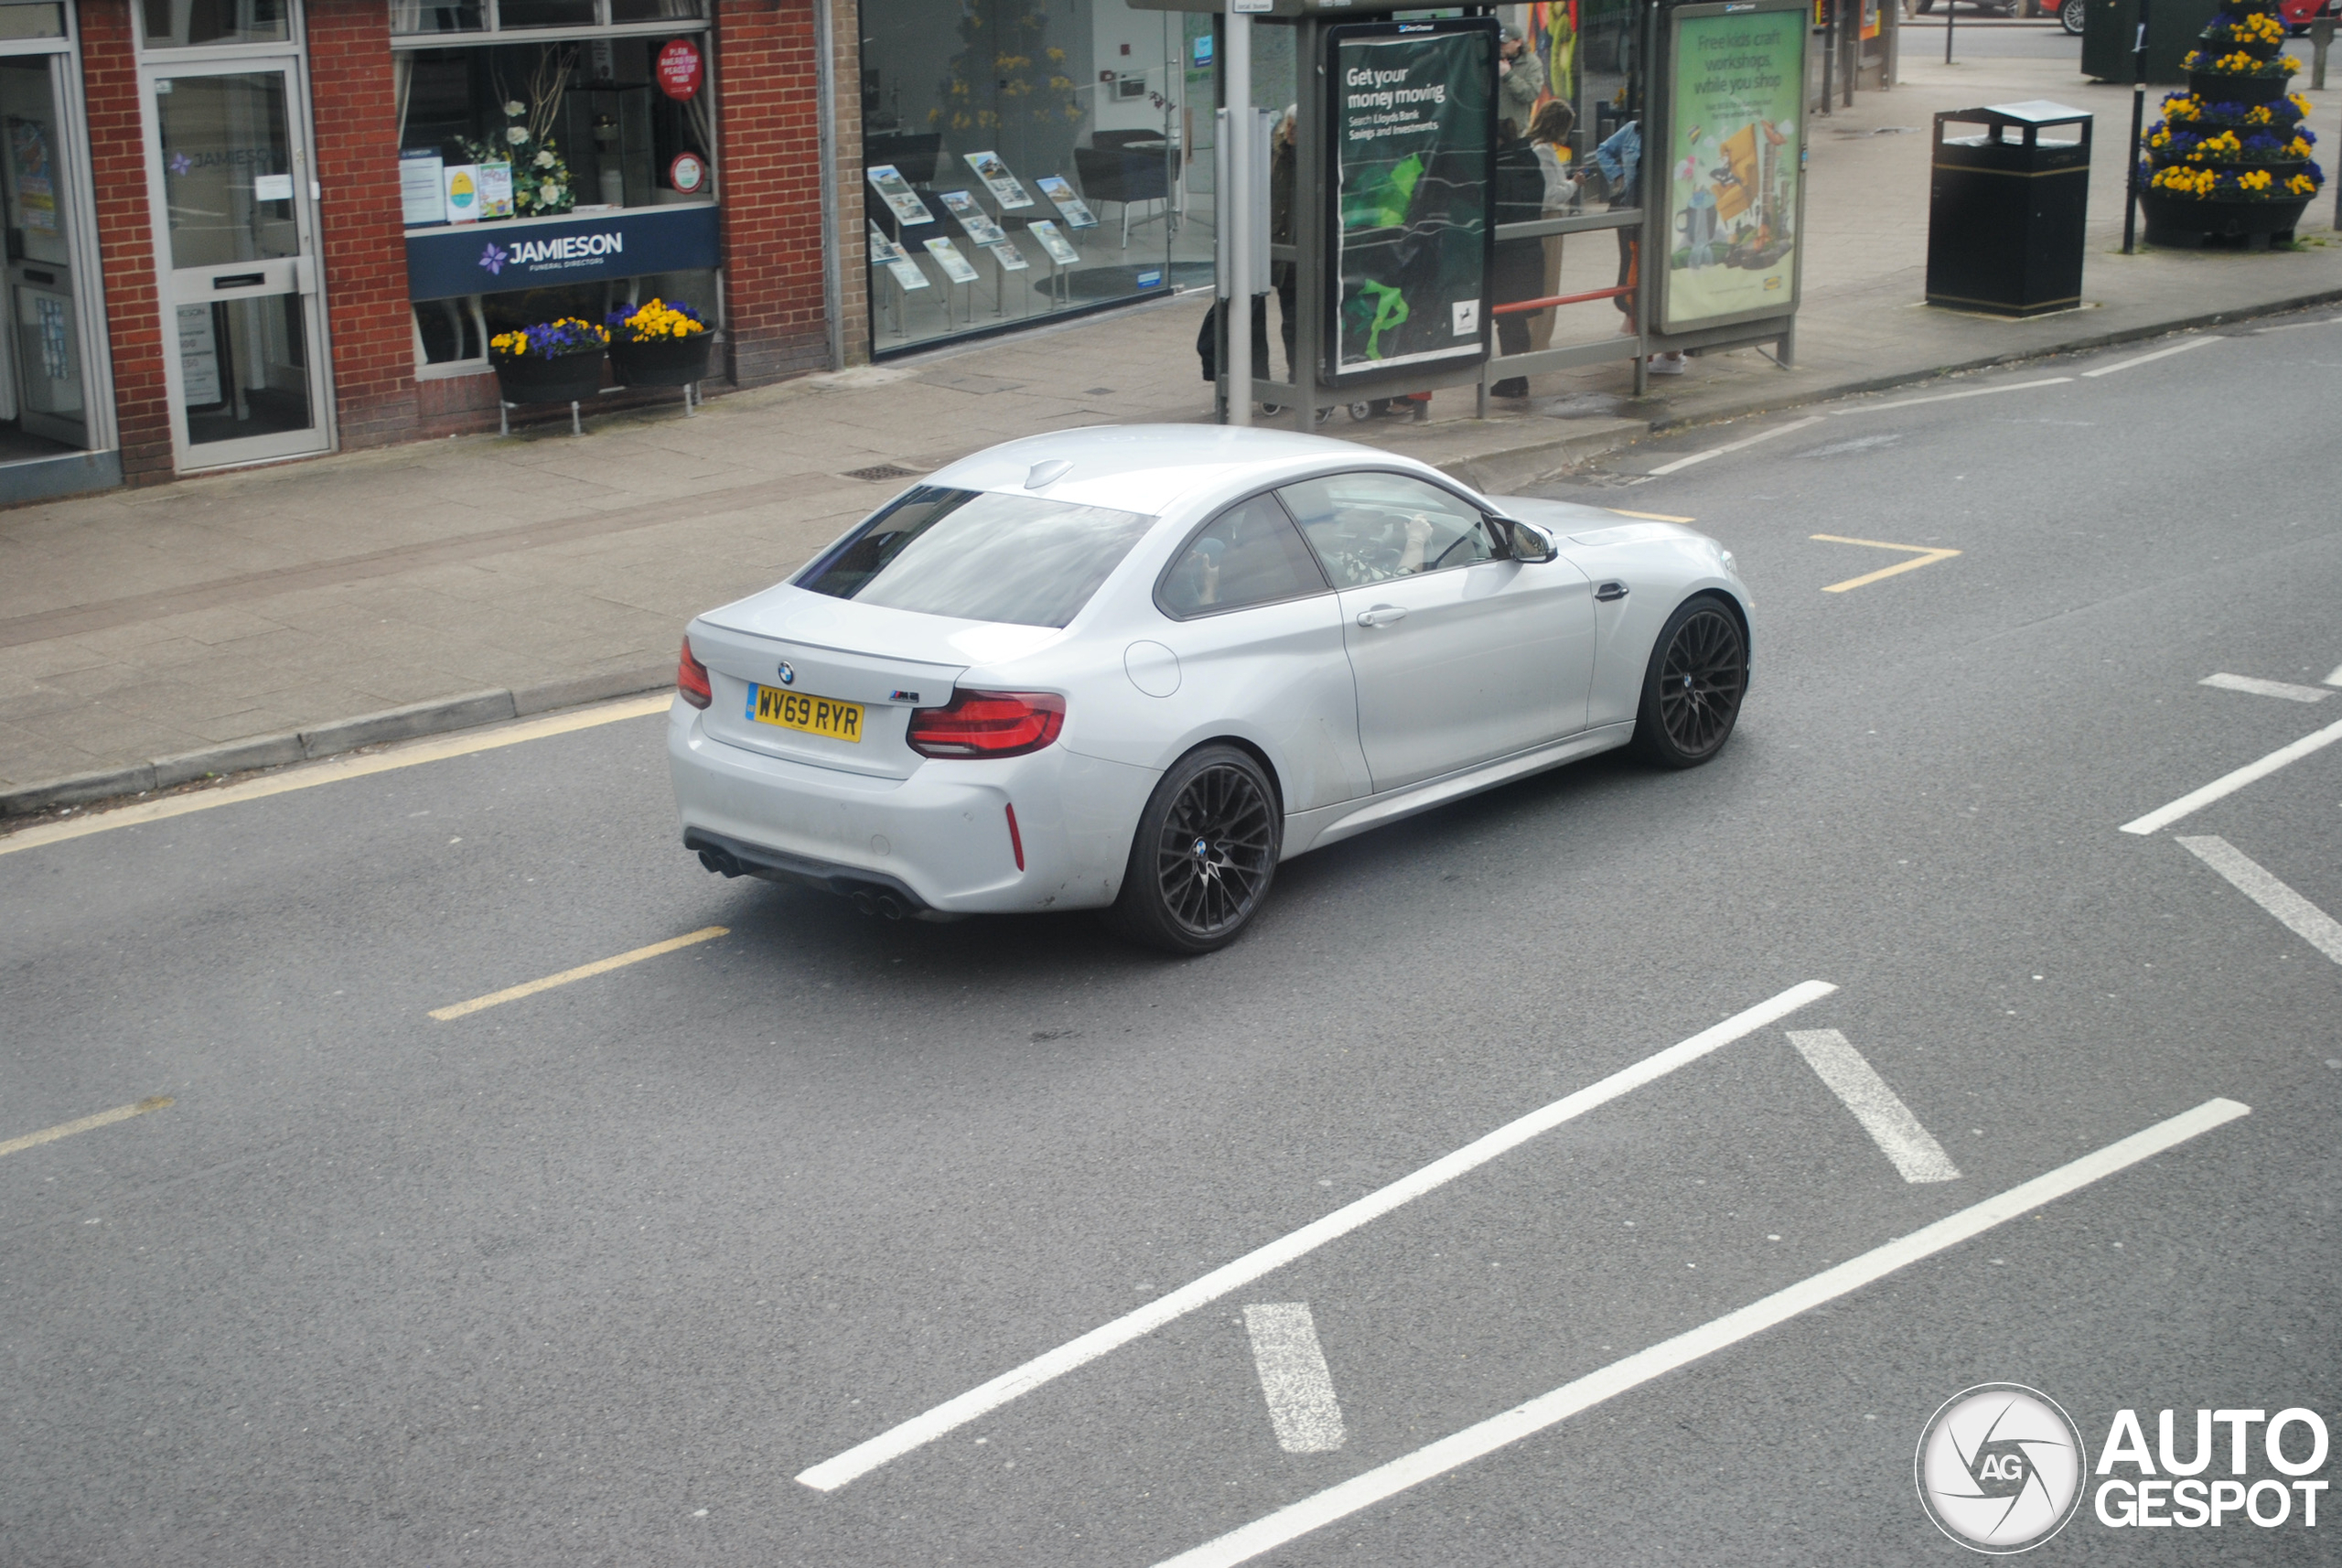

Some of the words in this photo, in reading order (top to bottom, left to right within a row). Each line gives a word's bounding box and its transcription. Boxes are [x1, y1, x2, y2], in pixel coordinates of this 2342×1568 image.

[1698, 36, 1724, 49] Free
[1727, 33, 1750, 47] kids
[1754, 29, 1780, 46] craft
[670, 48, 688, 56] PLAN
[664, 66, 685, 75] PEACE
[1347, 68, 1373, 87] Get
[1374, 69, 1409, 89] your
[1694, 76, 1726, 93] while
[1729, 77, 1751, 95] you
[1755, 73, 1781, 91] shop
[1348, 91, 1393, 110] money
[1395, 83, 1445, 103] moving
[1348, 115, 1371, 127] Search
[1373, 112, 1399, 124] Lloyds
[1400, 110, 1419, 121] Bank
[1348, 129, 1375, 140] Savings
[1376, 126, 1391, 136] and
[510, 232, 622, 264] JAMIESON
[529, 263, 563, 272] FUNERAL
[564, 257, 604, 268] DIRECTORS
[759, 690, 811, 725] WV69
[815, 702, 858, 736] RYR
